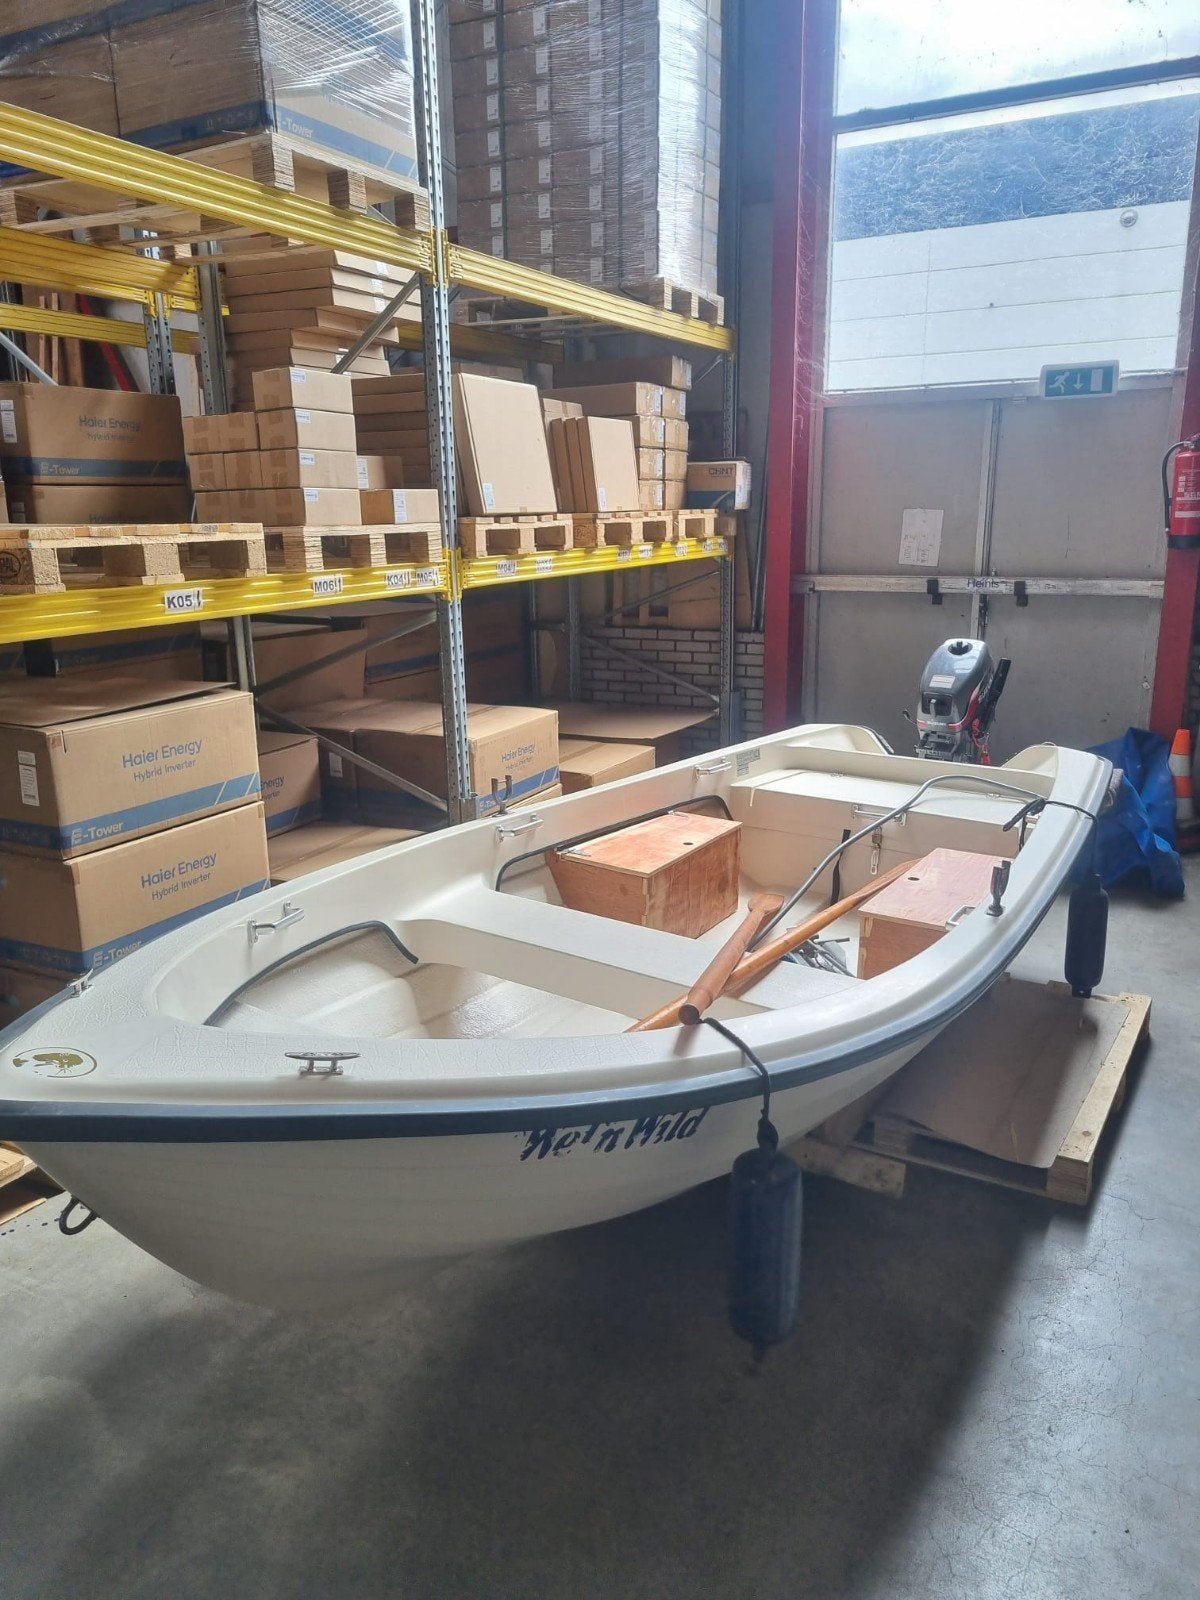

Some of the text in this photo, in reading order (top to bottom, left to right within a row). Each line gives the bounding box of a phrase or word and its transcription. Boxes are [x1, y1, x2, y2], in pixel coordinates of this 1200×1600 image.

[109, 418, 142, 432] Energy
[313, 580, 335, 593] M06
[387, 573, 403, 587] K04
[416, 571, 433, 583] M05
[166, 594, 193, 610] K05
[122, 739, 203, 768] Haier Energy
[133, 759, 196, 782] Hybrid Inverter
[71, 821, 124, 847] E-Tower
[141, 852, 217, 888] Haier Energy
[151, 872, 212, 901] Hybrid Inverter
